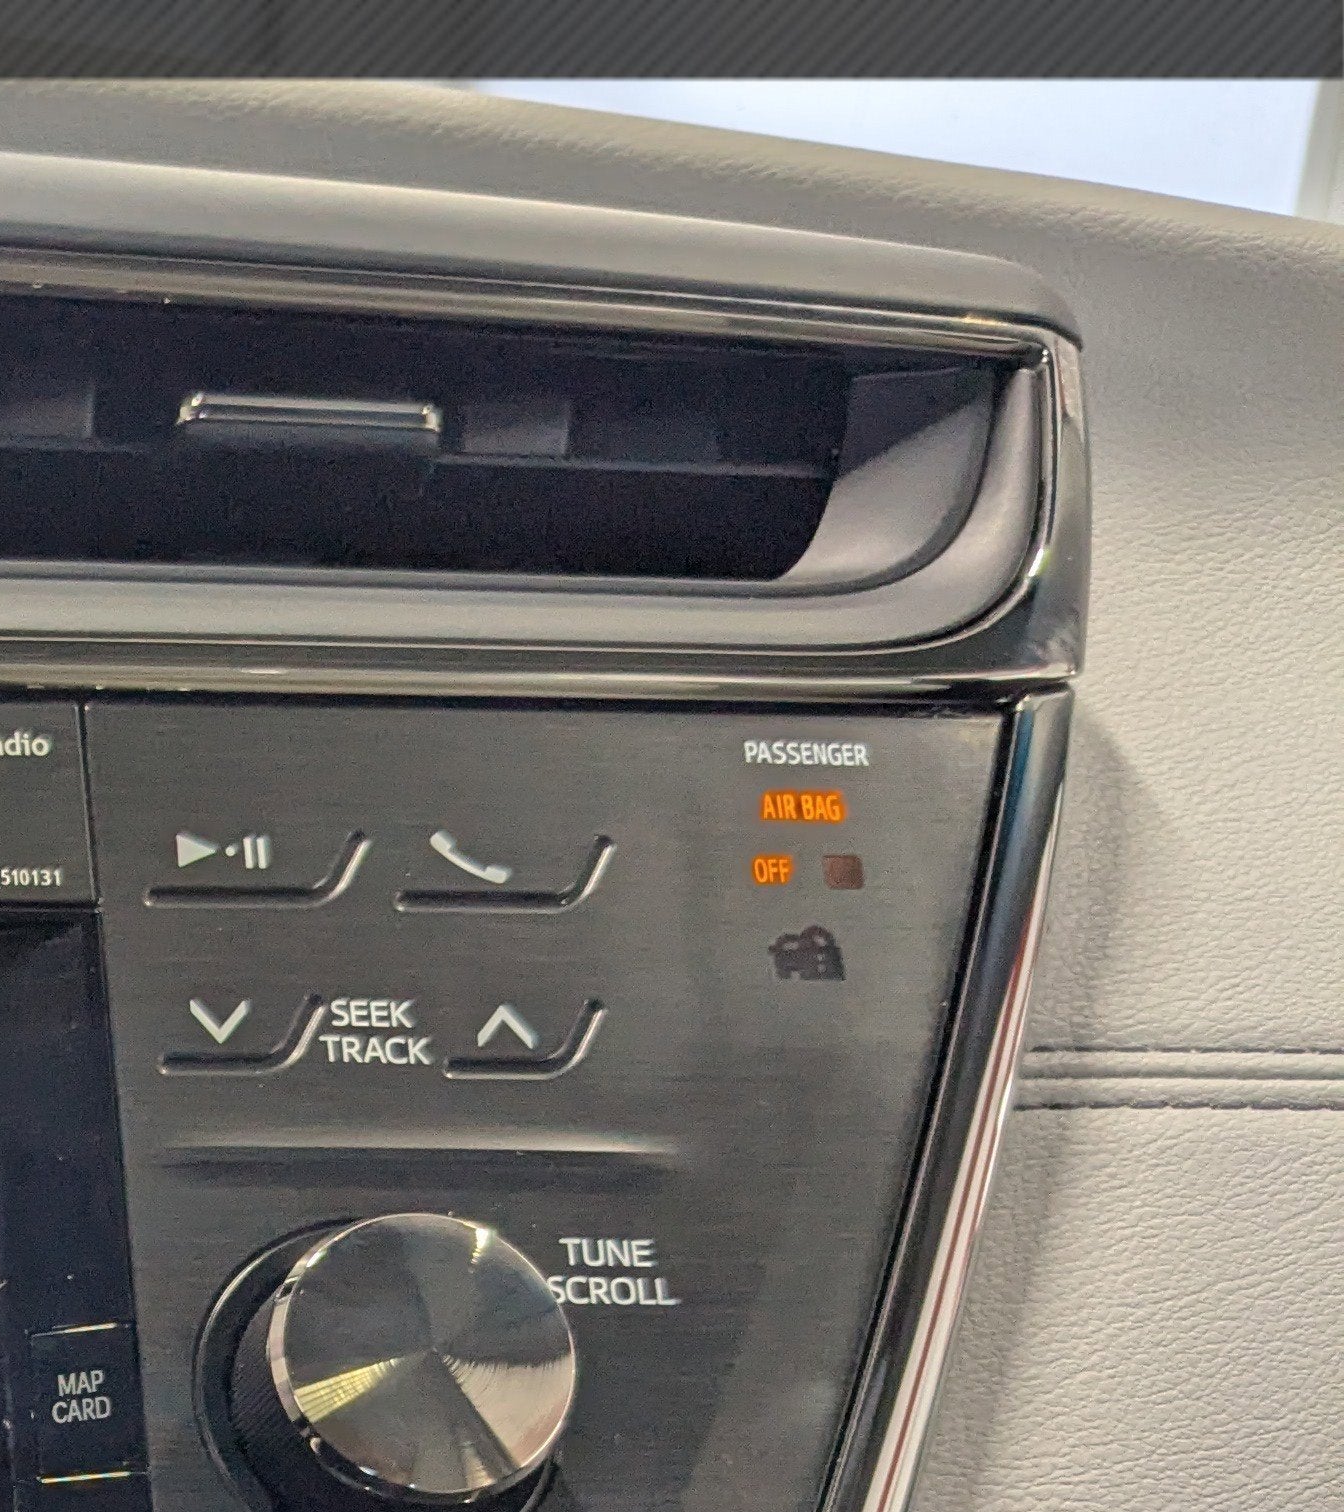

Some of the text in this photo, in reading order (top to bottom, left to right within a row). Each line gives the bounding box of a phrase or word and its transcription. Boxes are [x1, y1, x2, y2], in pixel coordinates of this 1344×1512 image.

[743, 740, 870, 766] PASSENGER
[763, 793, 842, 821] AIR BAG
[0, 867, 62, 887] 510131
[753, 858, 790, 883] OFF
[330, 999, 416, 1029] SEEK
[319, 1034, 433, 1065] TRACK
[558, 1237, 657, 1268] TUNE
[544, 1275, 681, 1306] SCROLL
[57, 1370, 104, 1397] MAP
[51, 1396, 112, 1424] CARD
